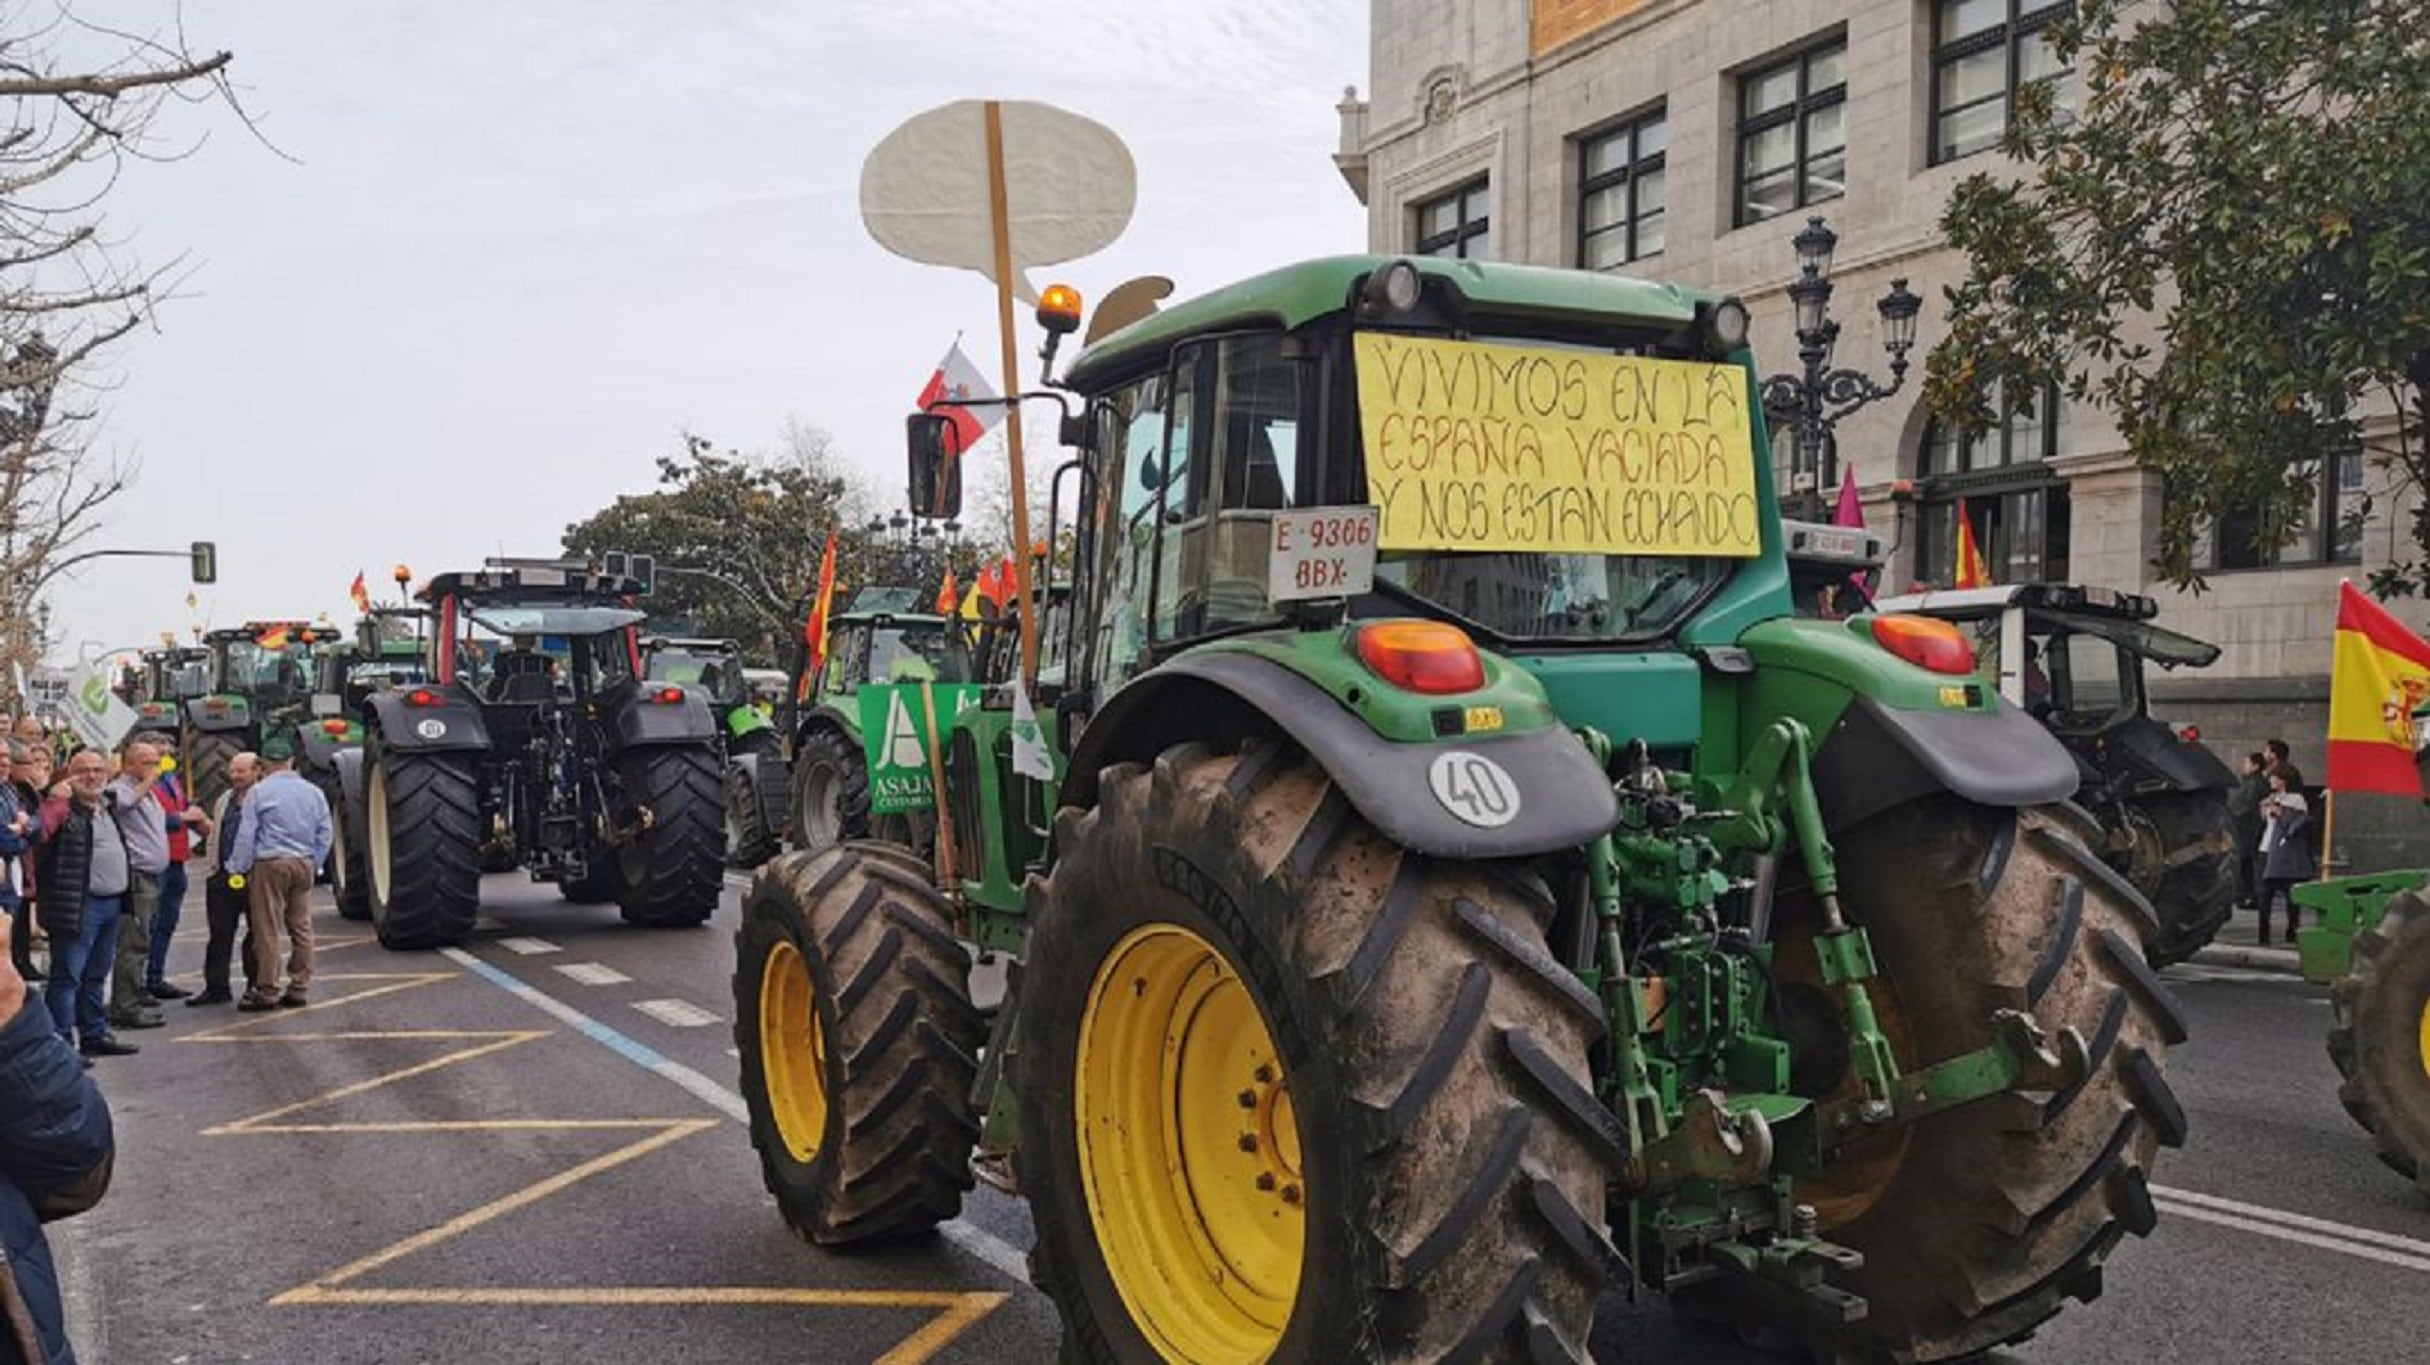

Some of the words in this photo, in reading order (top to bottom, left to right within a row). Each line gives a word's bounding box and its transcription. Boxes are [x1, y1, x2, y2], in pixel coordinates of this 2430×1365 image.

[1372, 340, 1588, 421] VIVIMOS
[1611, 364, 1661, 425] EN
[1683, 364, 1739, 429] LA
[1379, 412, 1546, 479] ESPAÑA
[1566, 427, 1729, 487] VACIADA
[1310, 517, 1372, 548] 9306
[1371, 478, 1404, 538] Y
[1417, 479, 1490, 542] NOS
[1502, 482, 1613, 544] ESTAN
[875, 775, 933, 797] ASAJA
[1446, 759, 1509, 816] 40
